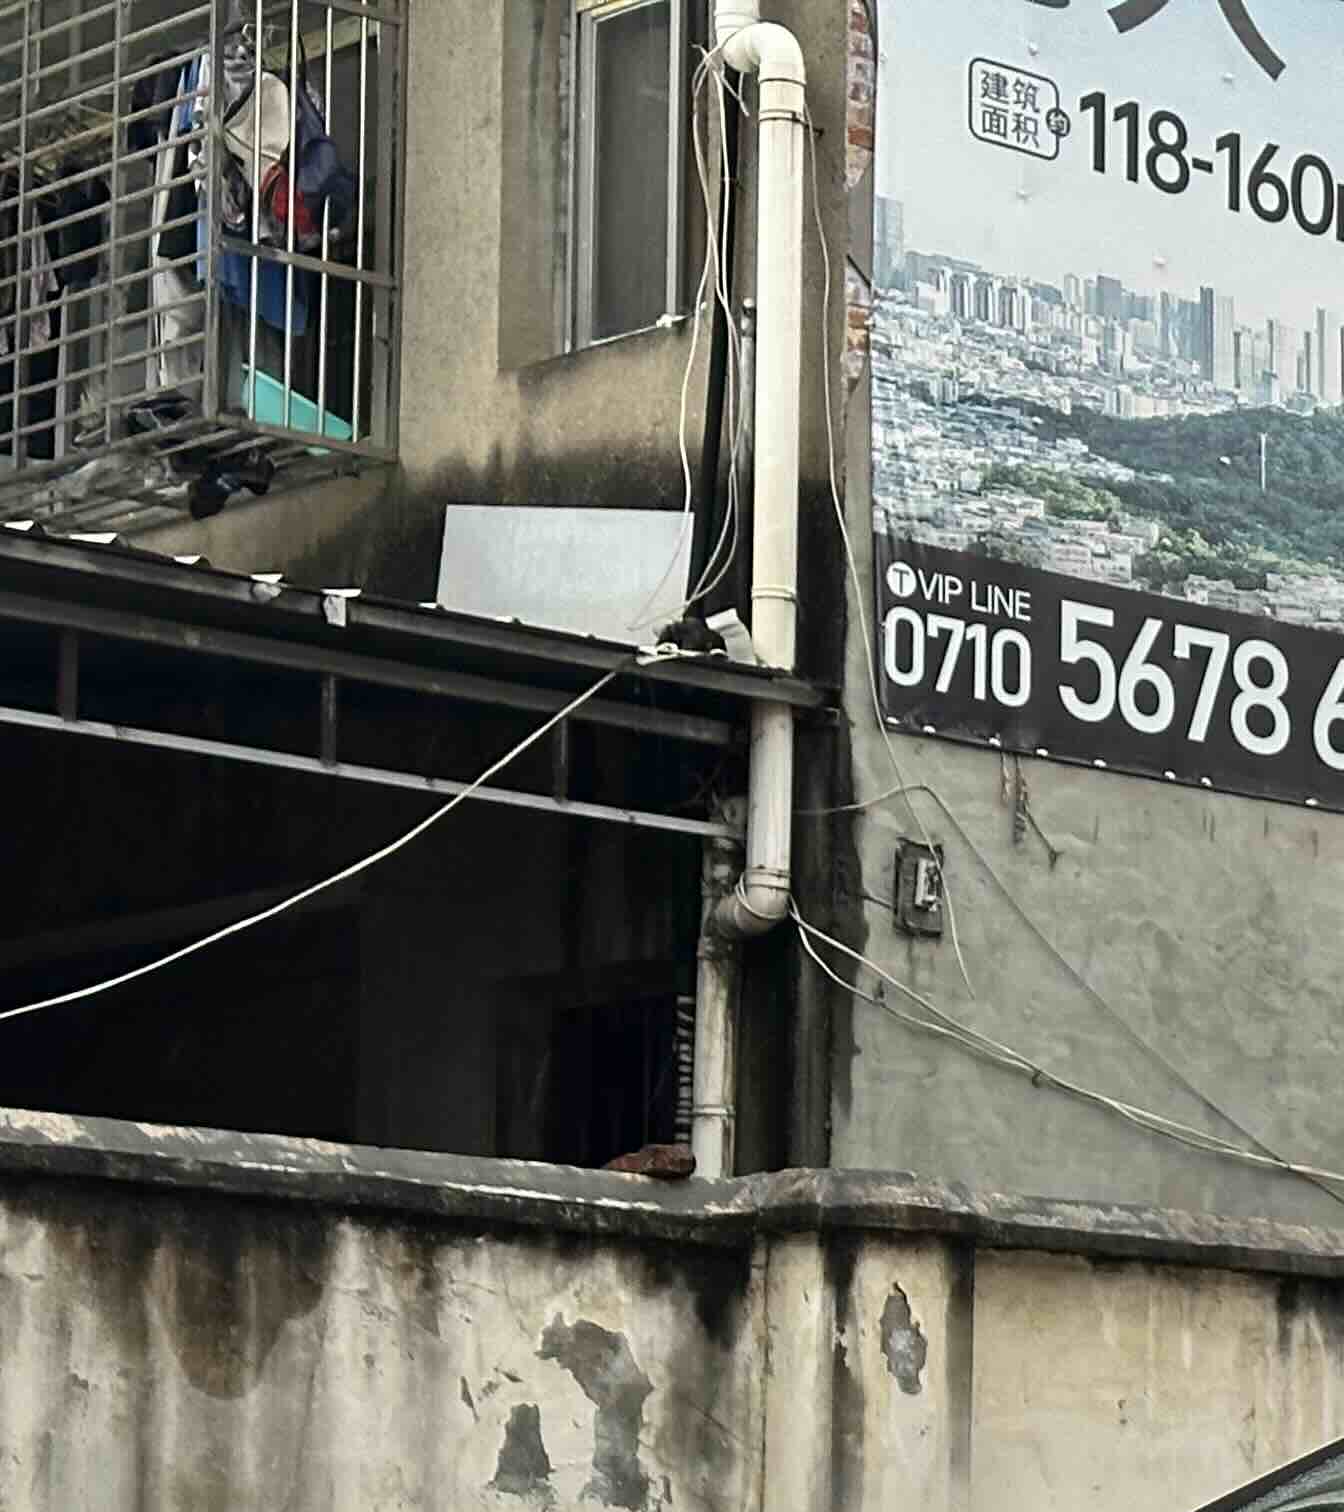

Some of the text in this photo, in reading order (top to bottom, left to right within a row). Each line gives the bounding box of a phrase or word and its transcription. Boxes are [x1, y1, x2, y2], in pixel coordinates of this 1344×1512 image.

[917, 568, 963, 605] VIP
[971, 580, 1032, 622] LINE
[884, 606, 1032, 707] 0710
[1058, 599, 1292, 756] 5678
